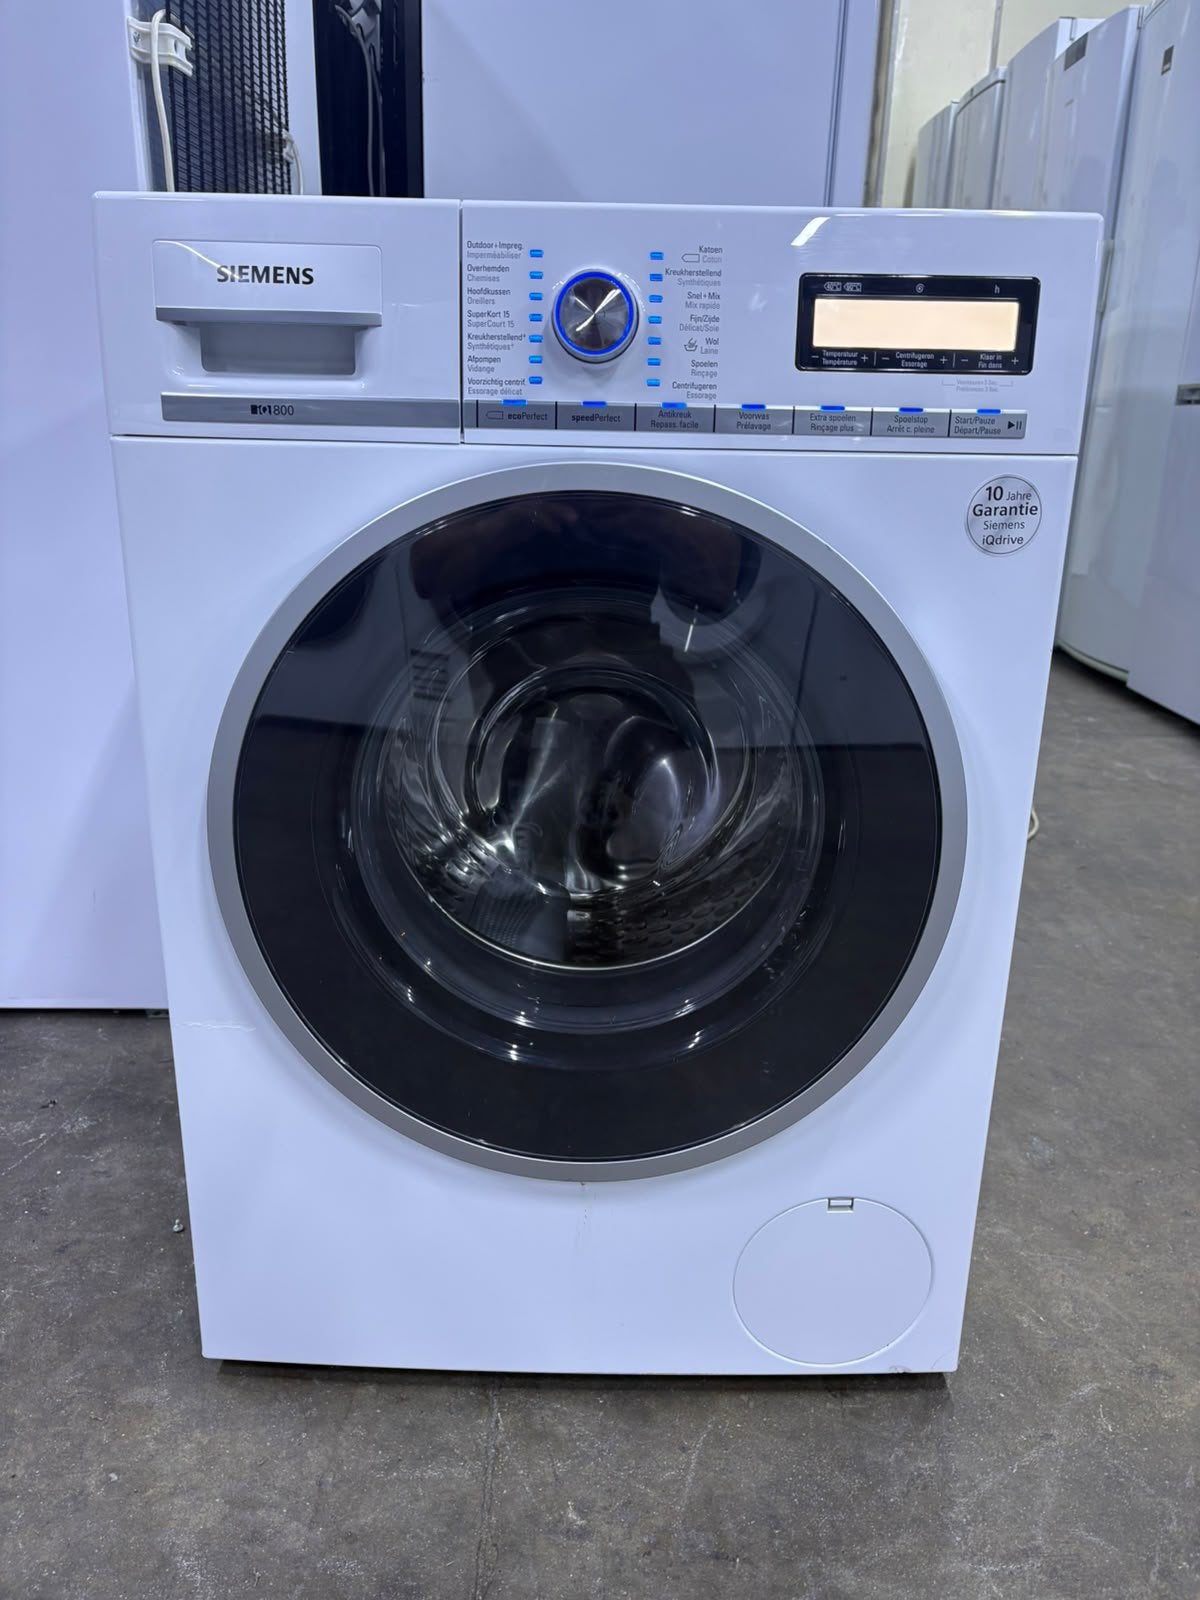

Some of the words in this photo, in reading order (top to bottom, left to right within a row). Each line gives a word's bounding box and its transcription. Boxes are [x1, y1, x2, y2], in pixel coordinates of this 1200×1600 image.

[699, 246, 723, 254] Katoen
[467, 264, 510, 273] Overhemden
[665, 268, 722, 277] Kreukherstellend
[217, 265, 314, 285] SIEMENS
[467, 274, 500, 282] Chemises
[467, 287, 511, 296] Hoofdkussen
[467, 297, 495, 305] Oreillers
[685, 301, 698, 309] Mix
[699, 302, 721, 310] rapide
[467, 310, 501, 319] SuperKort
[503, 310, 510, 318] 15
[690, 314, 720, 324] Fijn/Zijde
[467, 319, 506, 328] SuperCourt
[508, 320, 515, 328] 15
[679, 323, 720, 332] Délicat/Soie
[701, 346, 719, 354] Laine
[822, 350, 859, 358] Temperatuur
[467, 355, 502, 363] Afpompen
[895, 352, 935, 360] Centrifugeren
[467, 364, 495, 373] Vidange
[691, 360, 718, 368] Spoelen
[901, 360, 928, 368] Essorage
[978, 361, 987, 369] Fin
[691, 369, 718, 378] Rinçage
[467, 377, 503, 387] Voorzichtig
[672, 381, 718, 391] Centrifugeren
[467, 387, 499, 396] Essorage
[686, 391, 717, 400] Essorage
[507, 411, 548, 420] ecoPerfect
[571, 413, 621, 423] speedPerfect
[658, 409, 692, 419] Antikreuk
[738, 412, 769, 420] Voorwas
[809, 413, 827, 422] Extra
[828, 414, 857, 424] spoelen
[894, 415, 929, 424] Spoelstop
[954, 416, 996, 425] Start/Pauze
[679, 420, 699, 430] facile
[736, 421, 771, 432] Prélavage
[810, 423, 838, 433] Rinçage
[839, 424, 855, 432] plus
[913, 426, 935, 436] pleine
[985, 485, 1004, 502] 10
[1006, 491, 1032, 501] Jahre
[972, 502, 1038, 517] Garantie
[983, 520, 1025, 530] Siemens
[982, 534, 1024, 546] iQdrive
